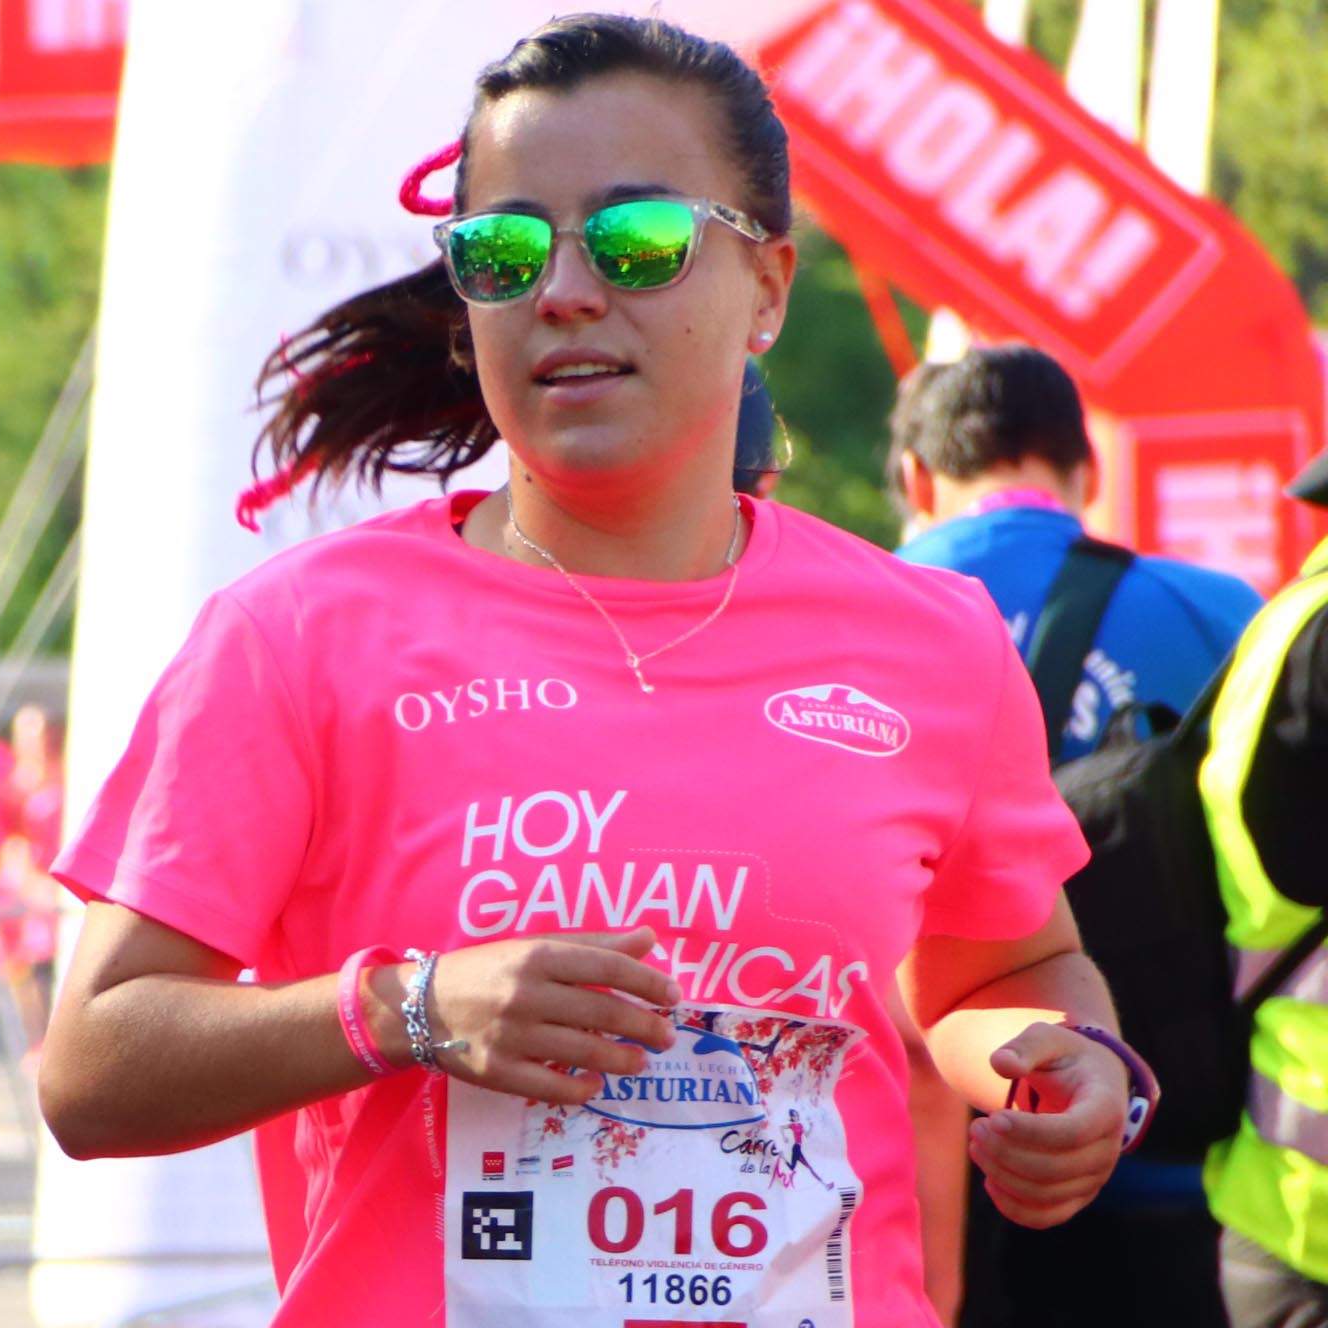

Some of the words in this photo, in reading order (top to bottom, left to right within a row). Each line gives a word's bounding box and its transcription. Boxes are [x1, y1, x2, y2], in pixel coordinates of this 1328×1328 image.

[394, 678, 578, 731] OYSHO
[778, 700, 899, 748] ASTURIANA
[460, 790, 627, 867] HOY
[458, 861, 748, 937] GANAN
[600, 1075, 760, 1107] ASTURIAN
[720, 1130, 780, 1156] Carre
[740, 1157, 755, 1173] de
[759, 1160, 770, 1174] la
[587, 1186, 768, 1258] 016
[647, 1260, 701, 1270] VIOLENCIA
[704, 1262, 717, 1270] DE
[618, 1272, 732, 1306] 11866
